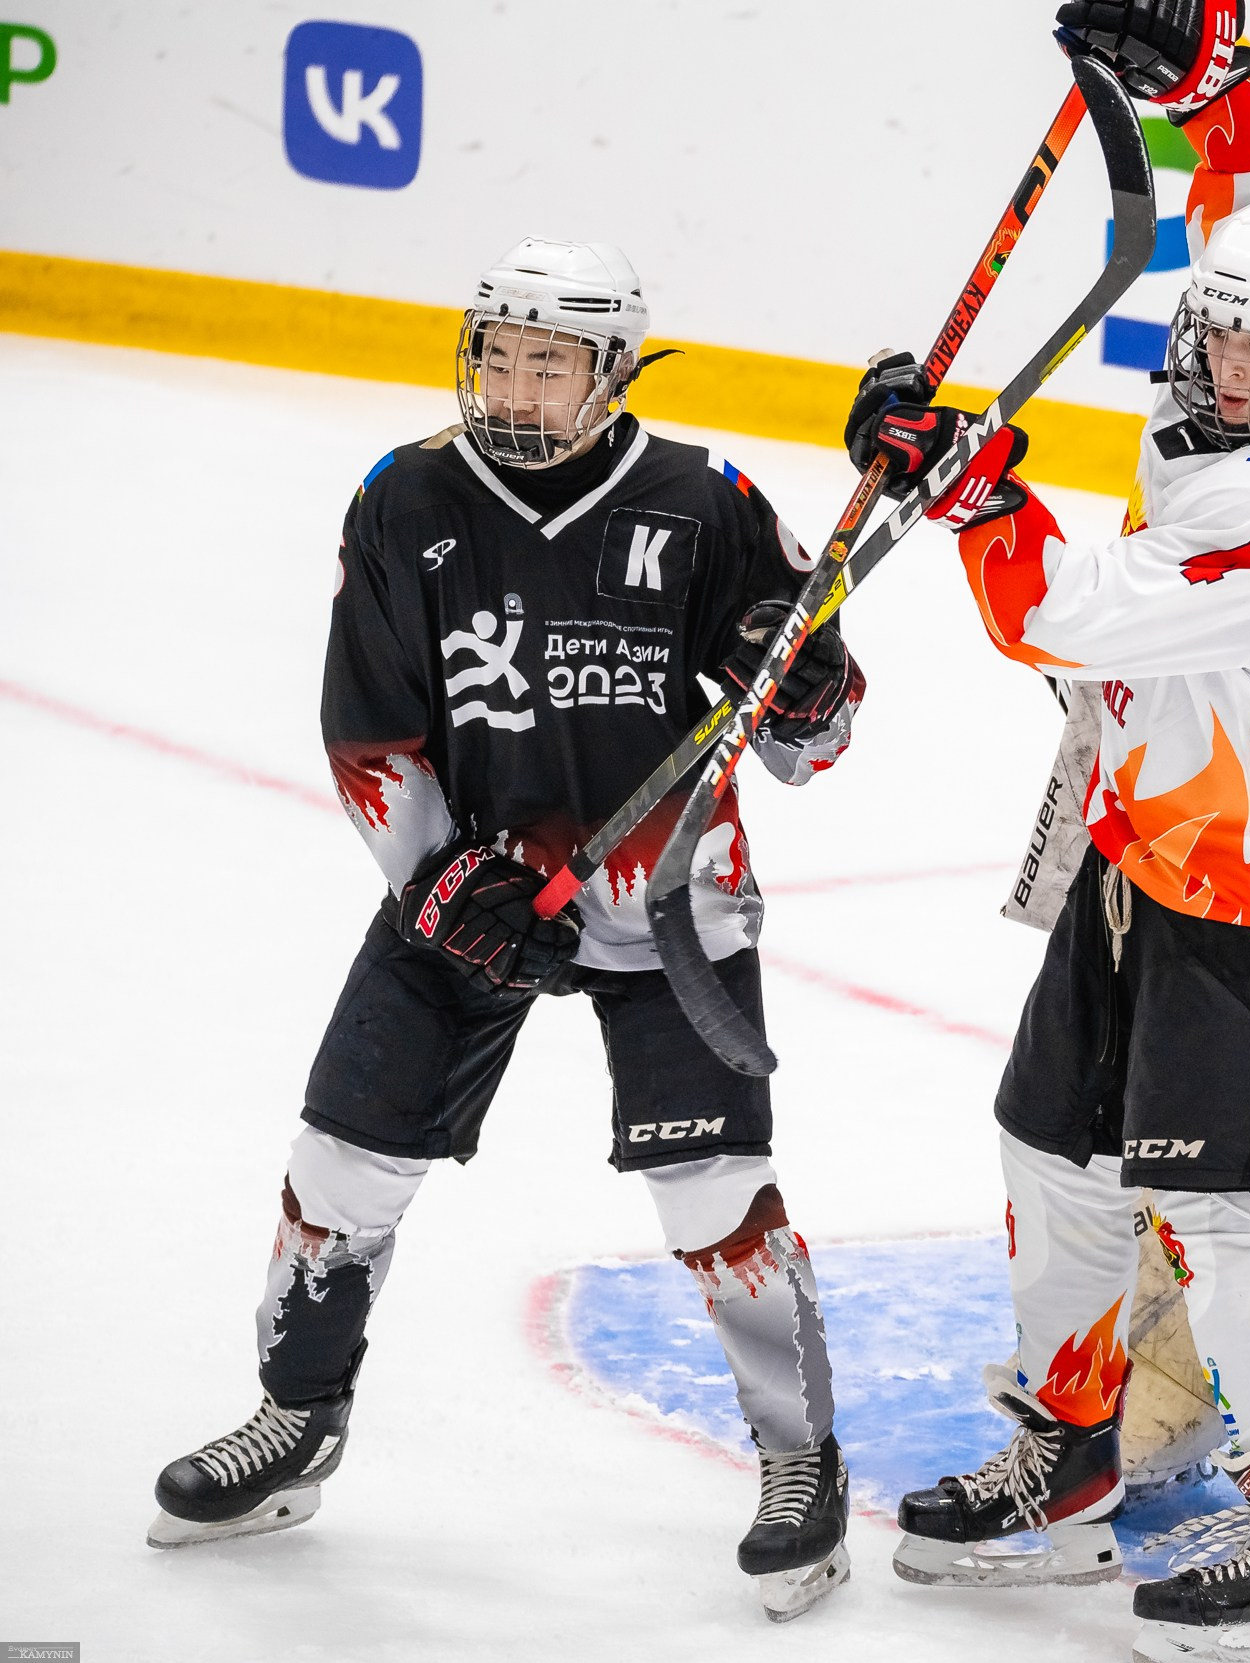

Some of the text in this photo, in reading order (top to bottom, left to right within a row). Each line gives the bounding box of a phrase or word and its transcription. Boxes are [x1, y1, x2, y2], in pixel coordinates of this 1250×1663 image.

[305, 65, 400, 150] VK
[1202, 286, 1249, 306] CCM
[884, 397, 1004, 541] CCM
[544, 634, 670, 663] Дети Азии
[549, 619, 574, 628] ЗИМНИЕ
[657, 626, 673, 636] ИГРЫ
[547, 664, 667, 715] 2023
[693, 699, 733, 746] SUPE
[1014, 775, 1064, 910] BAUER
[414, 846, 496, 938] CCM
[628, 1116, 726, 1143] CCM
[1123, 1139, 1206, 1160] CCM
